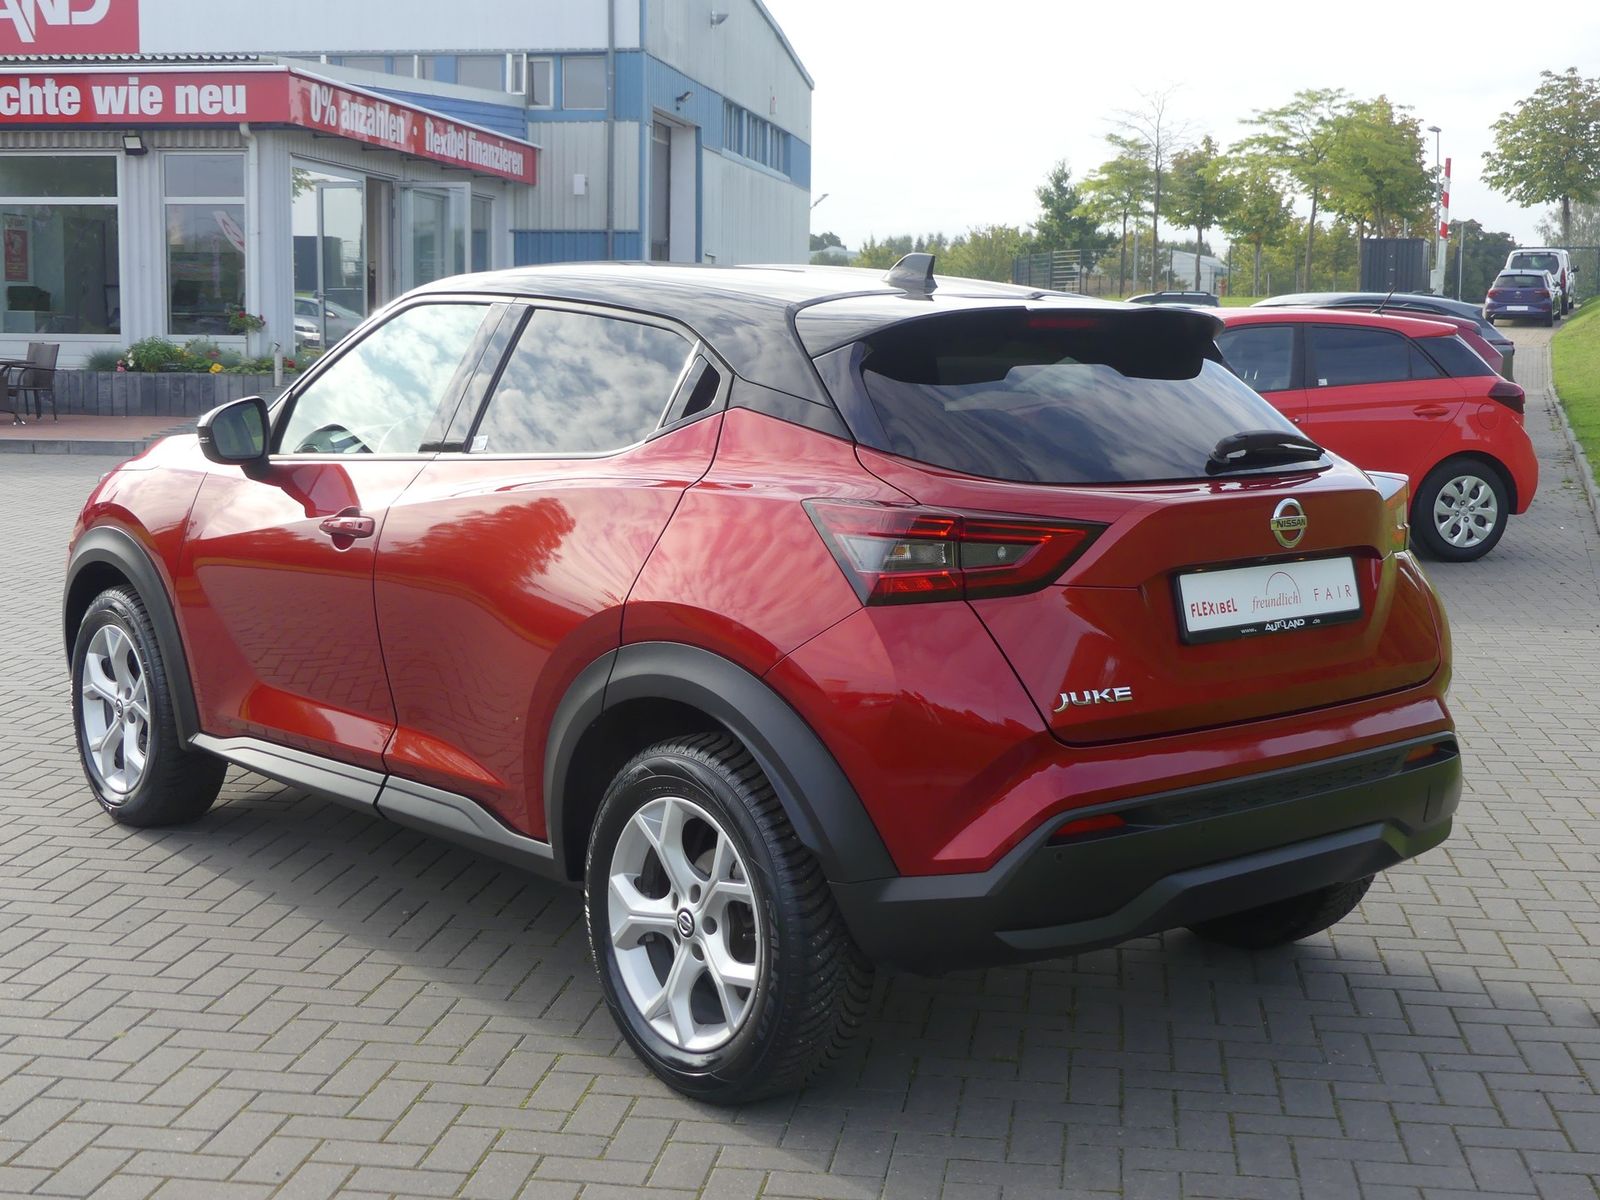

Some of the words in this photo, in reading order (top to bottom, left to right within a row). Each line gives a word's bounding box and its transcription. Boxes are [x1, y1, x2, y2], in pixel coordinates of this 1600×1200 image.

[0, 77, 81, 116] chte
[91, 76, 163, 116] wie
[175, 84, 247, 116] neu
[310, 82, 337, 127] 0%
[340, 99, 405, 145] anzahlen
[425, 116, 467, 162] flexibel
[468, 131, 524, 177] finanzieren
[1276, 518, 1306, 528] NISSAN
[1190, 597, 1238, 618] FLEXIBEL
[1251, 591, 1301, 614] freundlich
[1313, 584, 1352, 601] FAIR
[1265, 618, 1305, 632] AUTOLAND
[1053, 686, 1133, 713] JUKE
